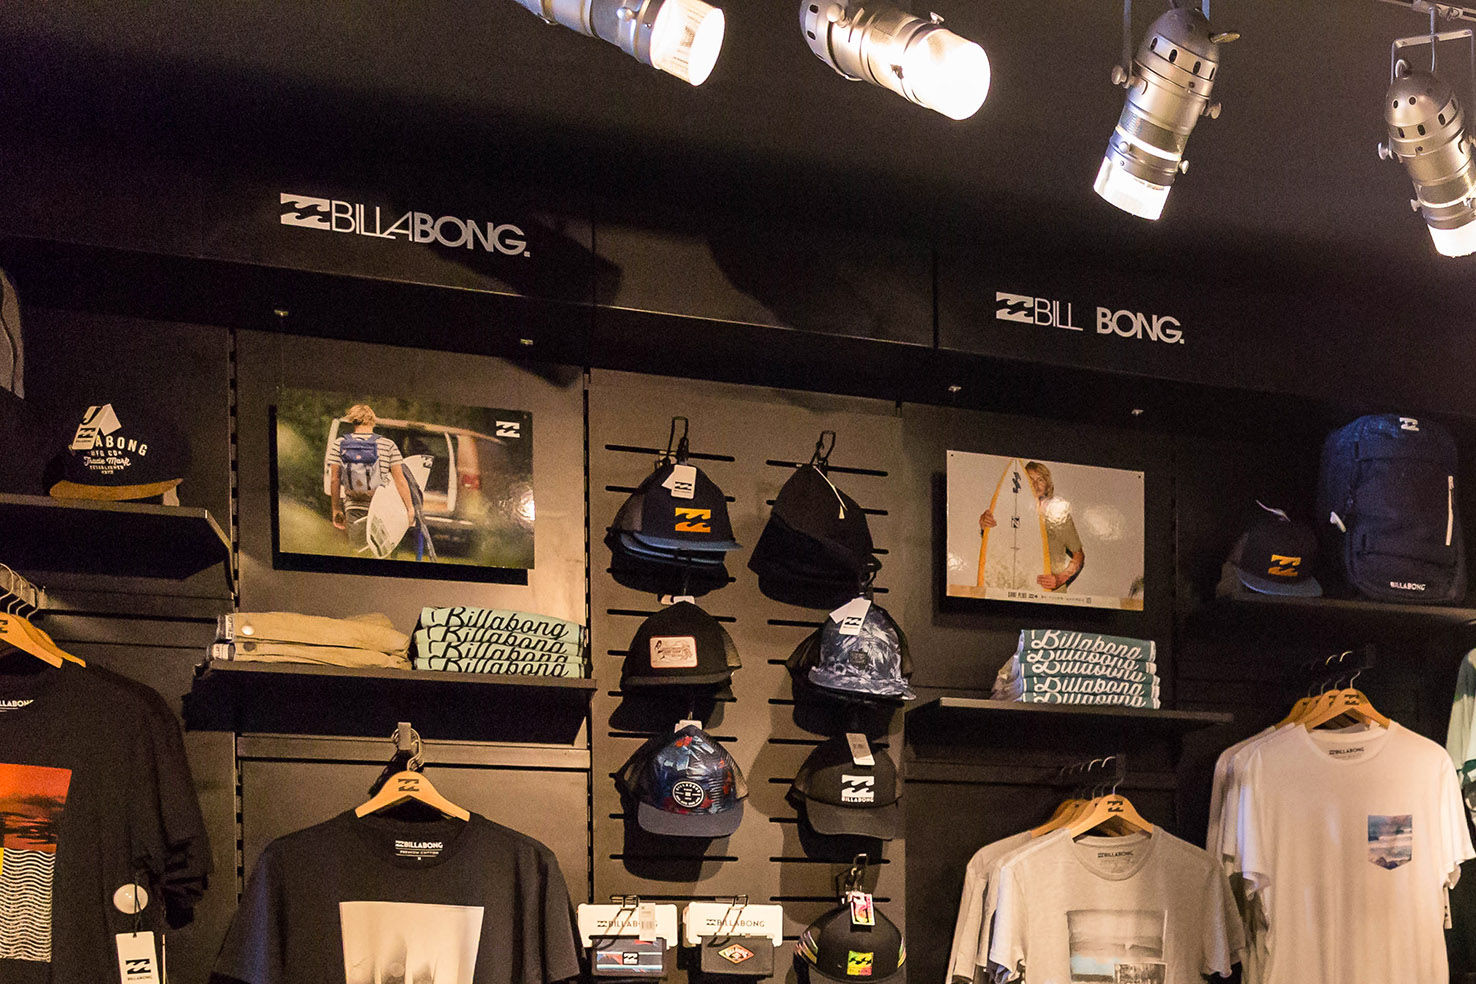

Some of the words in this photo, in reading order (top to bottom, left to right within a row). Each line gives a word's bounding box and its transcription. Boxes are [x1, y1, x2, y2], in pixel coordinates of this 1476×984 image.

[68, 434, 149, 457] ABONG
[430, 606, 570, 639] Billabong
[1031, 629, 1143, 660] Billabong
[403, 841, 443, 849] BILLABONG
[608, 918, 658, 930] BILLAB
[717, 918, 766, 929] BILLABONG
